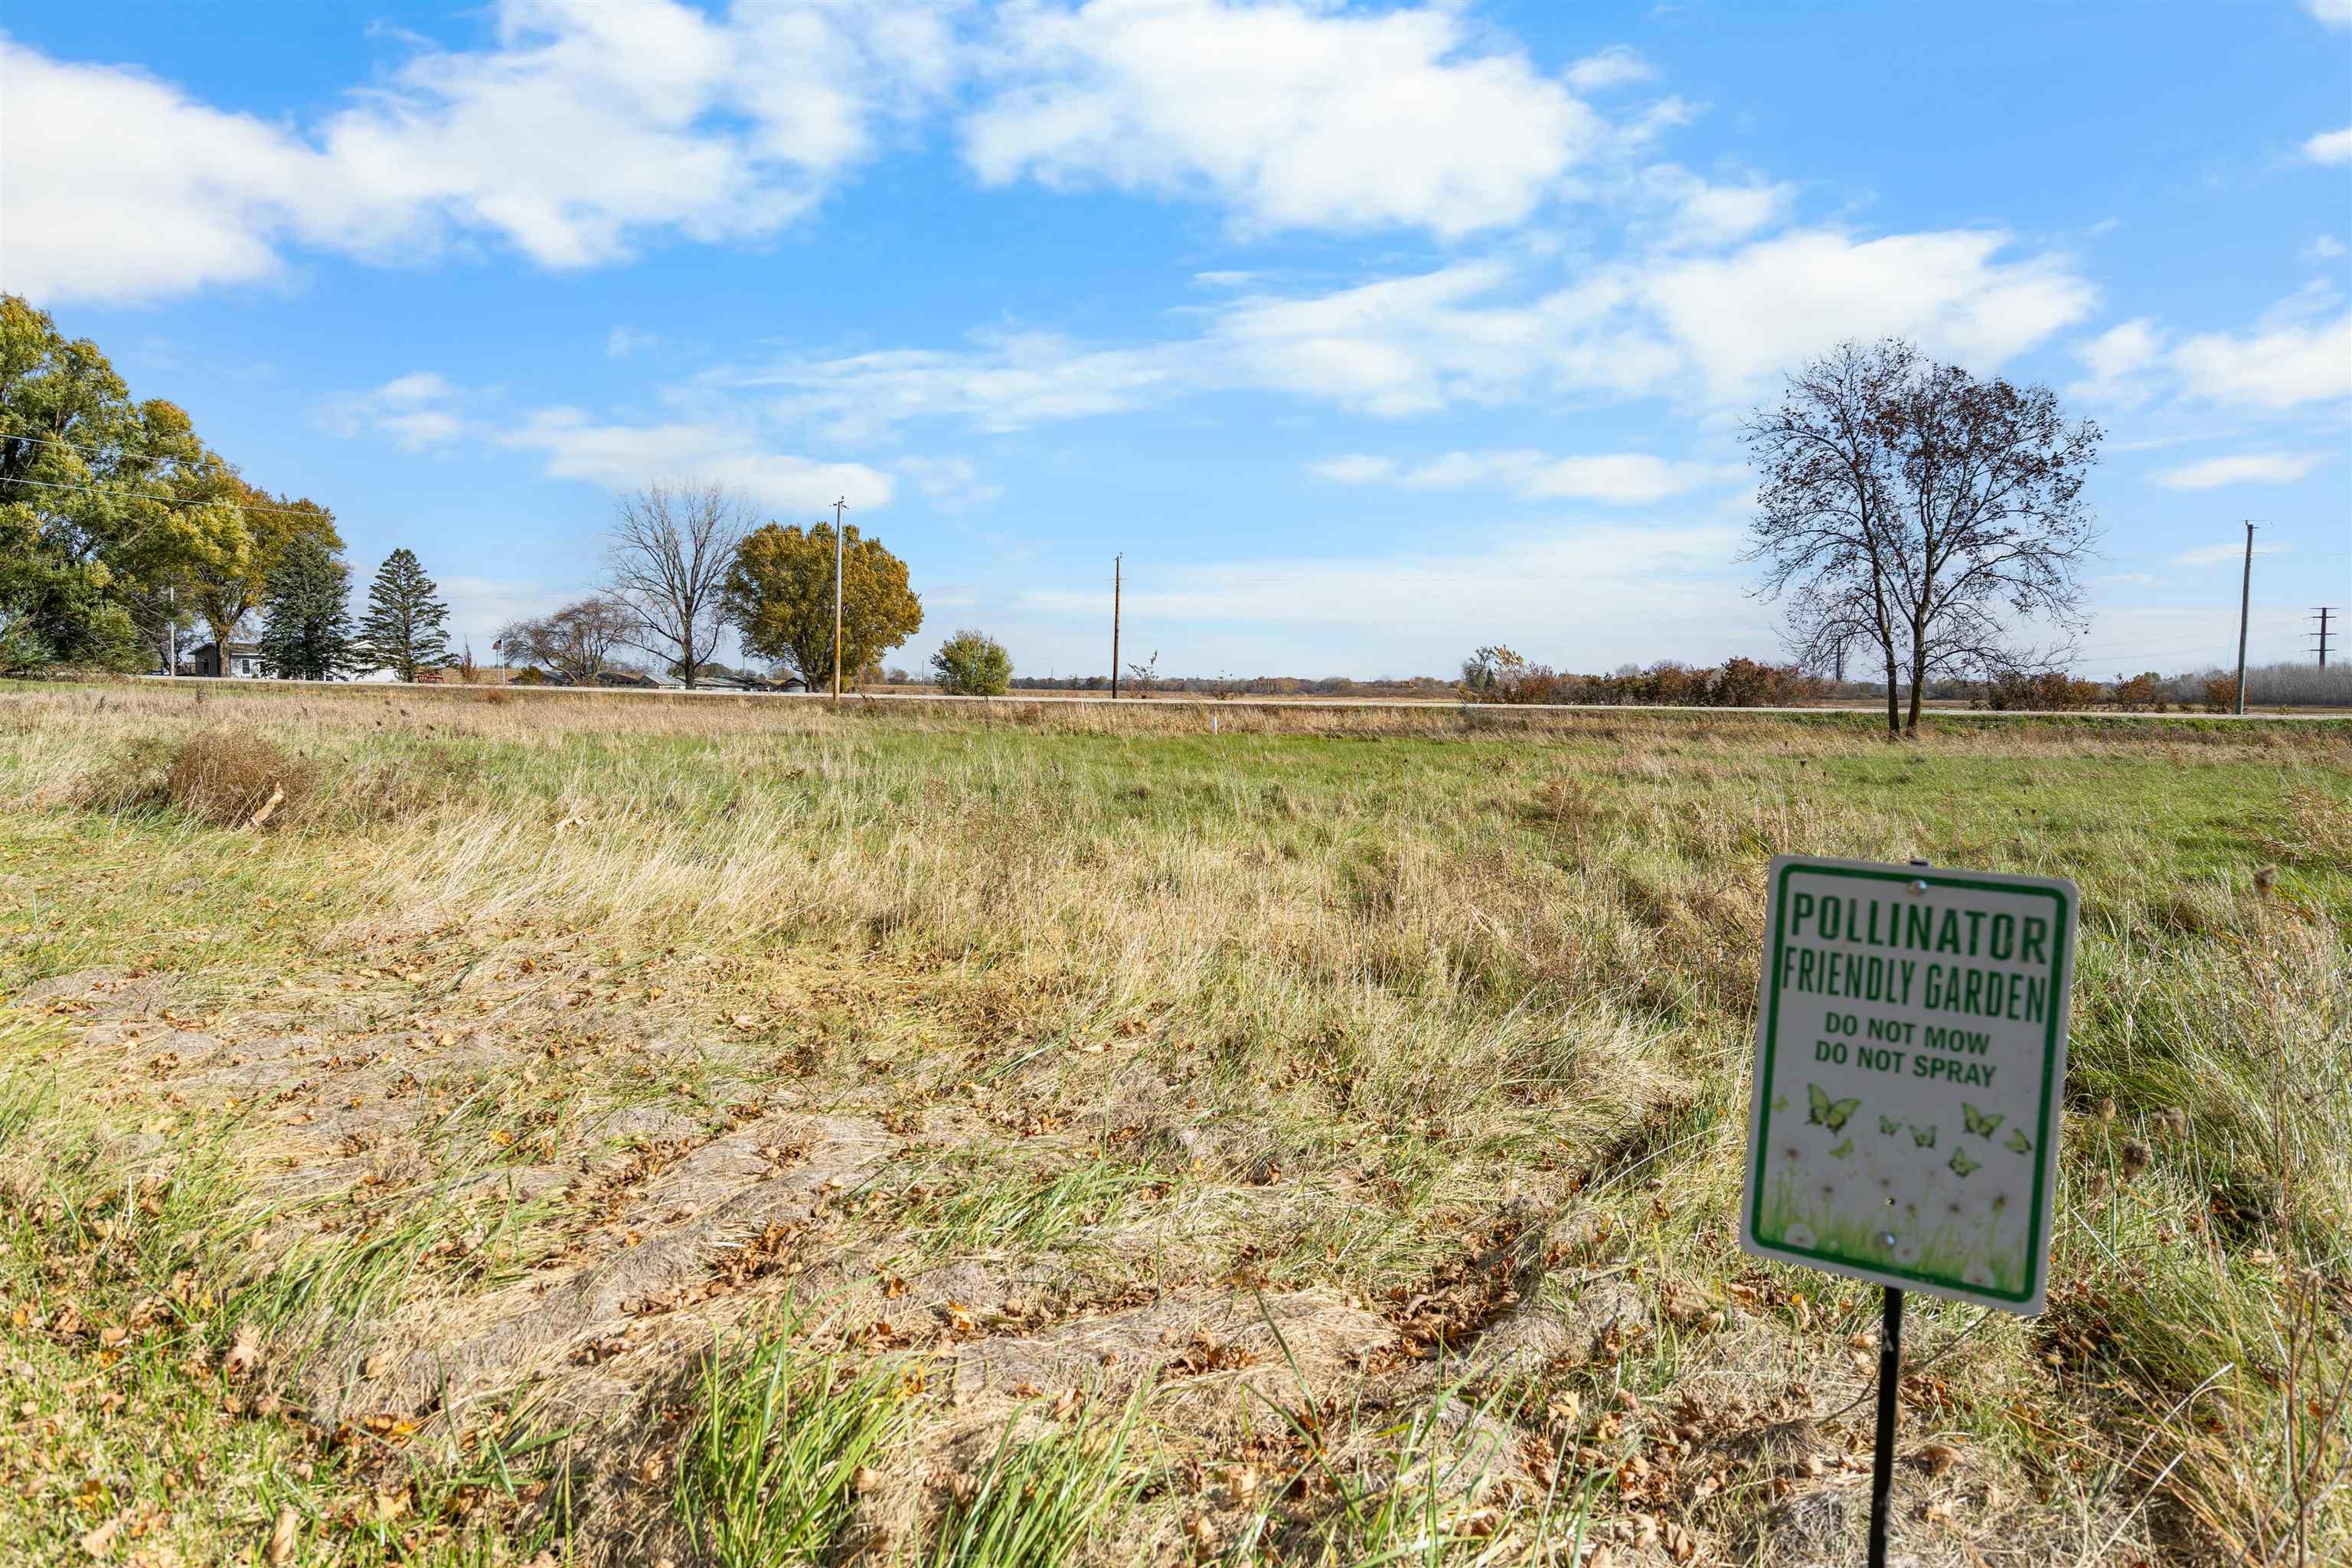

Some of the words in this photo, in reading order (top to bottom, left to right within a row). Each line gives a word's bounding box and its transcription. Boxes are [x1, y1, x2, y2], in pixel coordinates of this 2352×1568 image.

[1791, 893, 2048, 965] POLLINATOR
[1782, 946, 1916, 1005] FRIENDLY
[1924, 962, 2047, 1024] GARDEN
[1825, 1011, 1857, 1036] DO
[1868, 1018, 1916, 1044] NOT
[1924, 1026, 1991, 1056] MOW
[1815, 1040, 1847, 1064] DO
[1857, 1046, 1906, 1073] NOT
[1913, 1055, 1998, 1088] SPRAY
